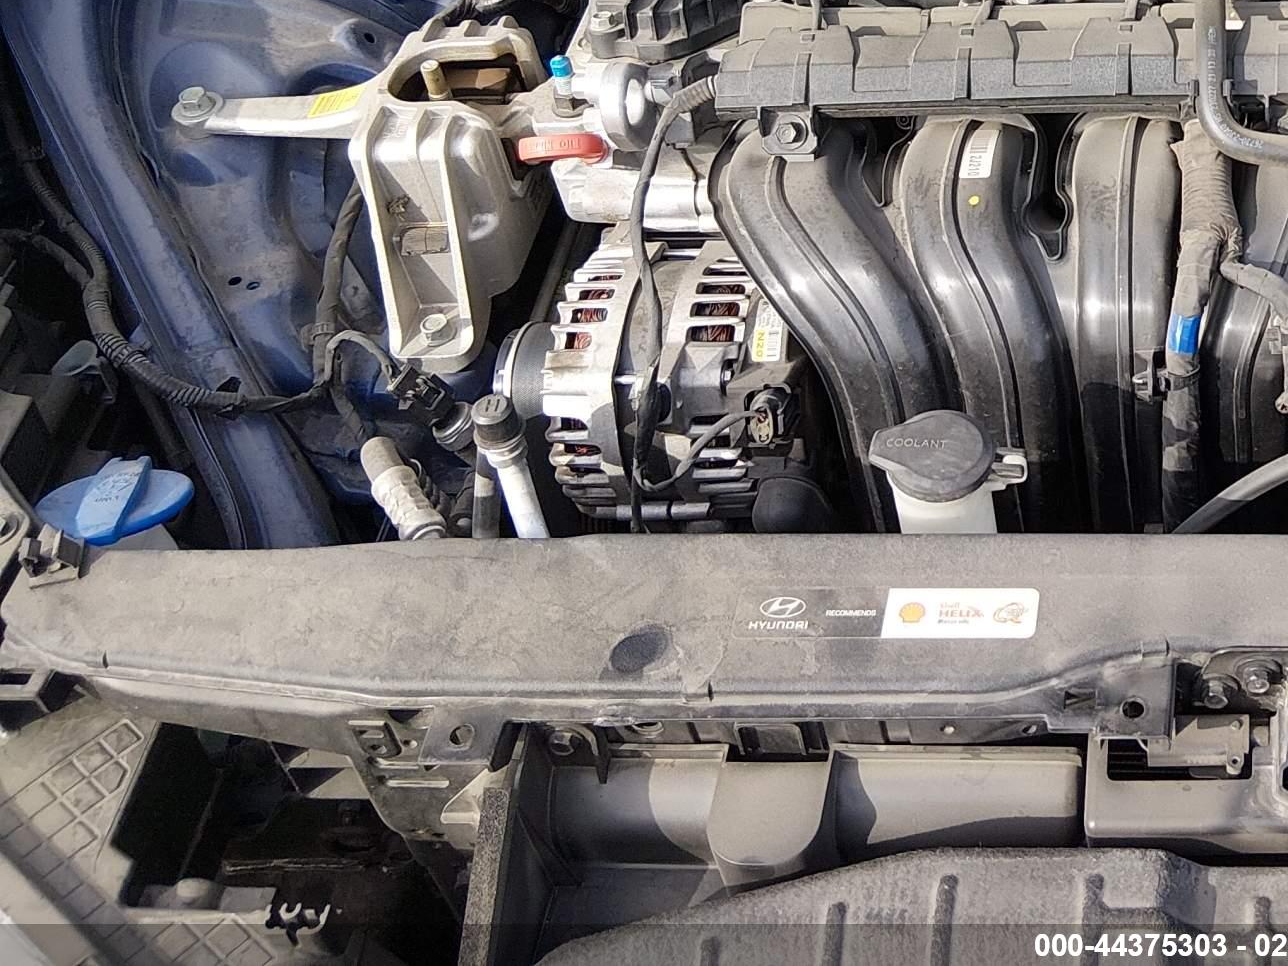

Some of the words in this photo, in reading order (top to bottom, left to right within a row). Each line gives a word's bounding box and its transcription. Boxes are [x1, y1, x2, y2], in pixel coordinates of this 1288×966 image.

[886, 437, 947, 450] COOLANT
[825, 609, 877, 617] RECOMMENDS
[938, 609, 982, 618] HELIX
[748, 620, 810, 630] HYUNDAI
